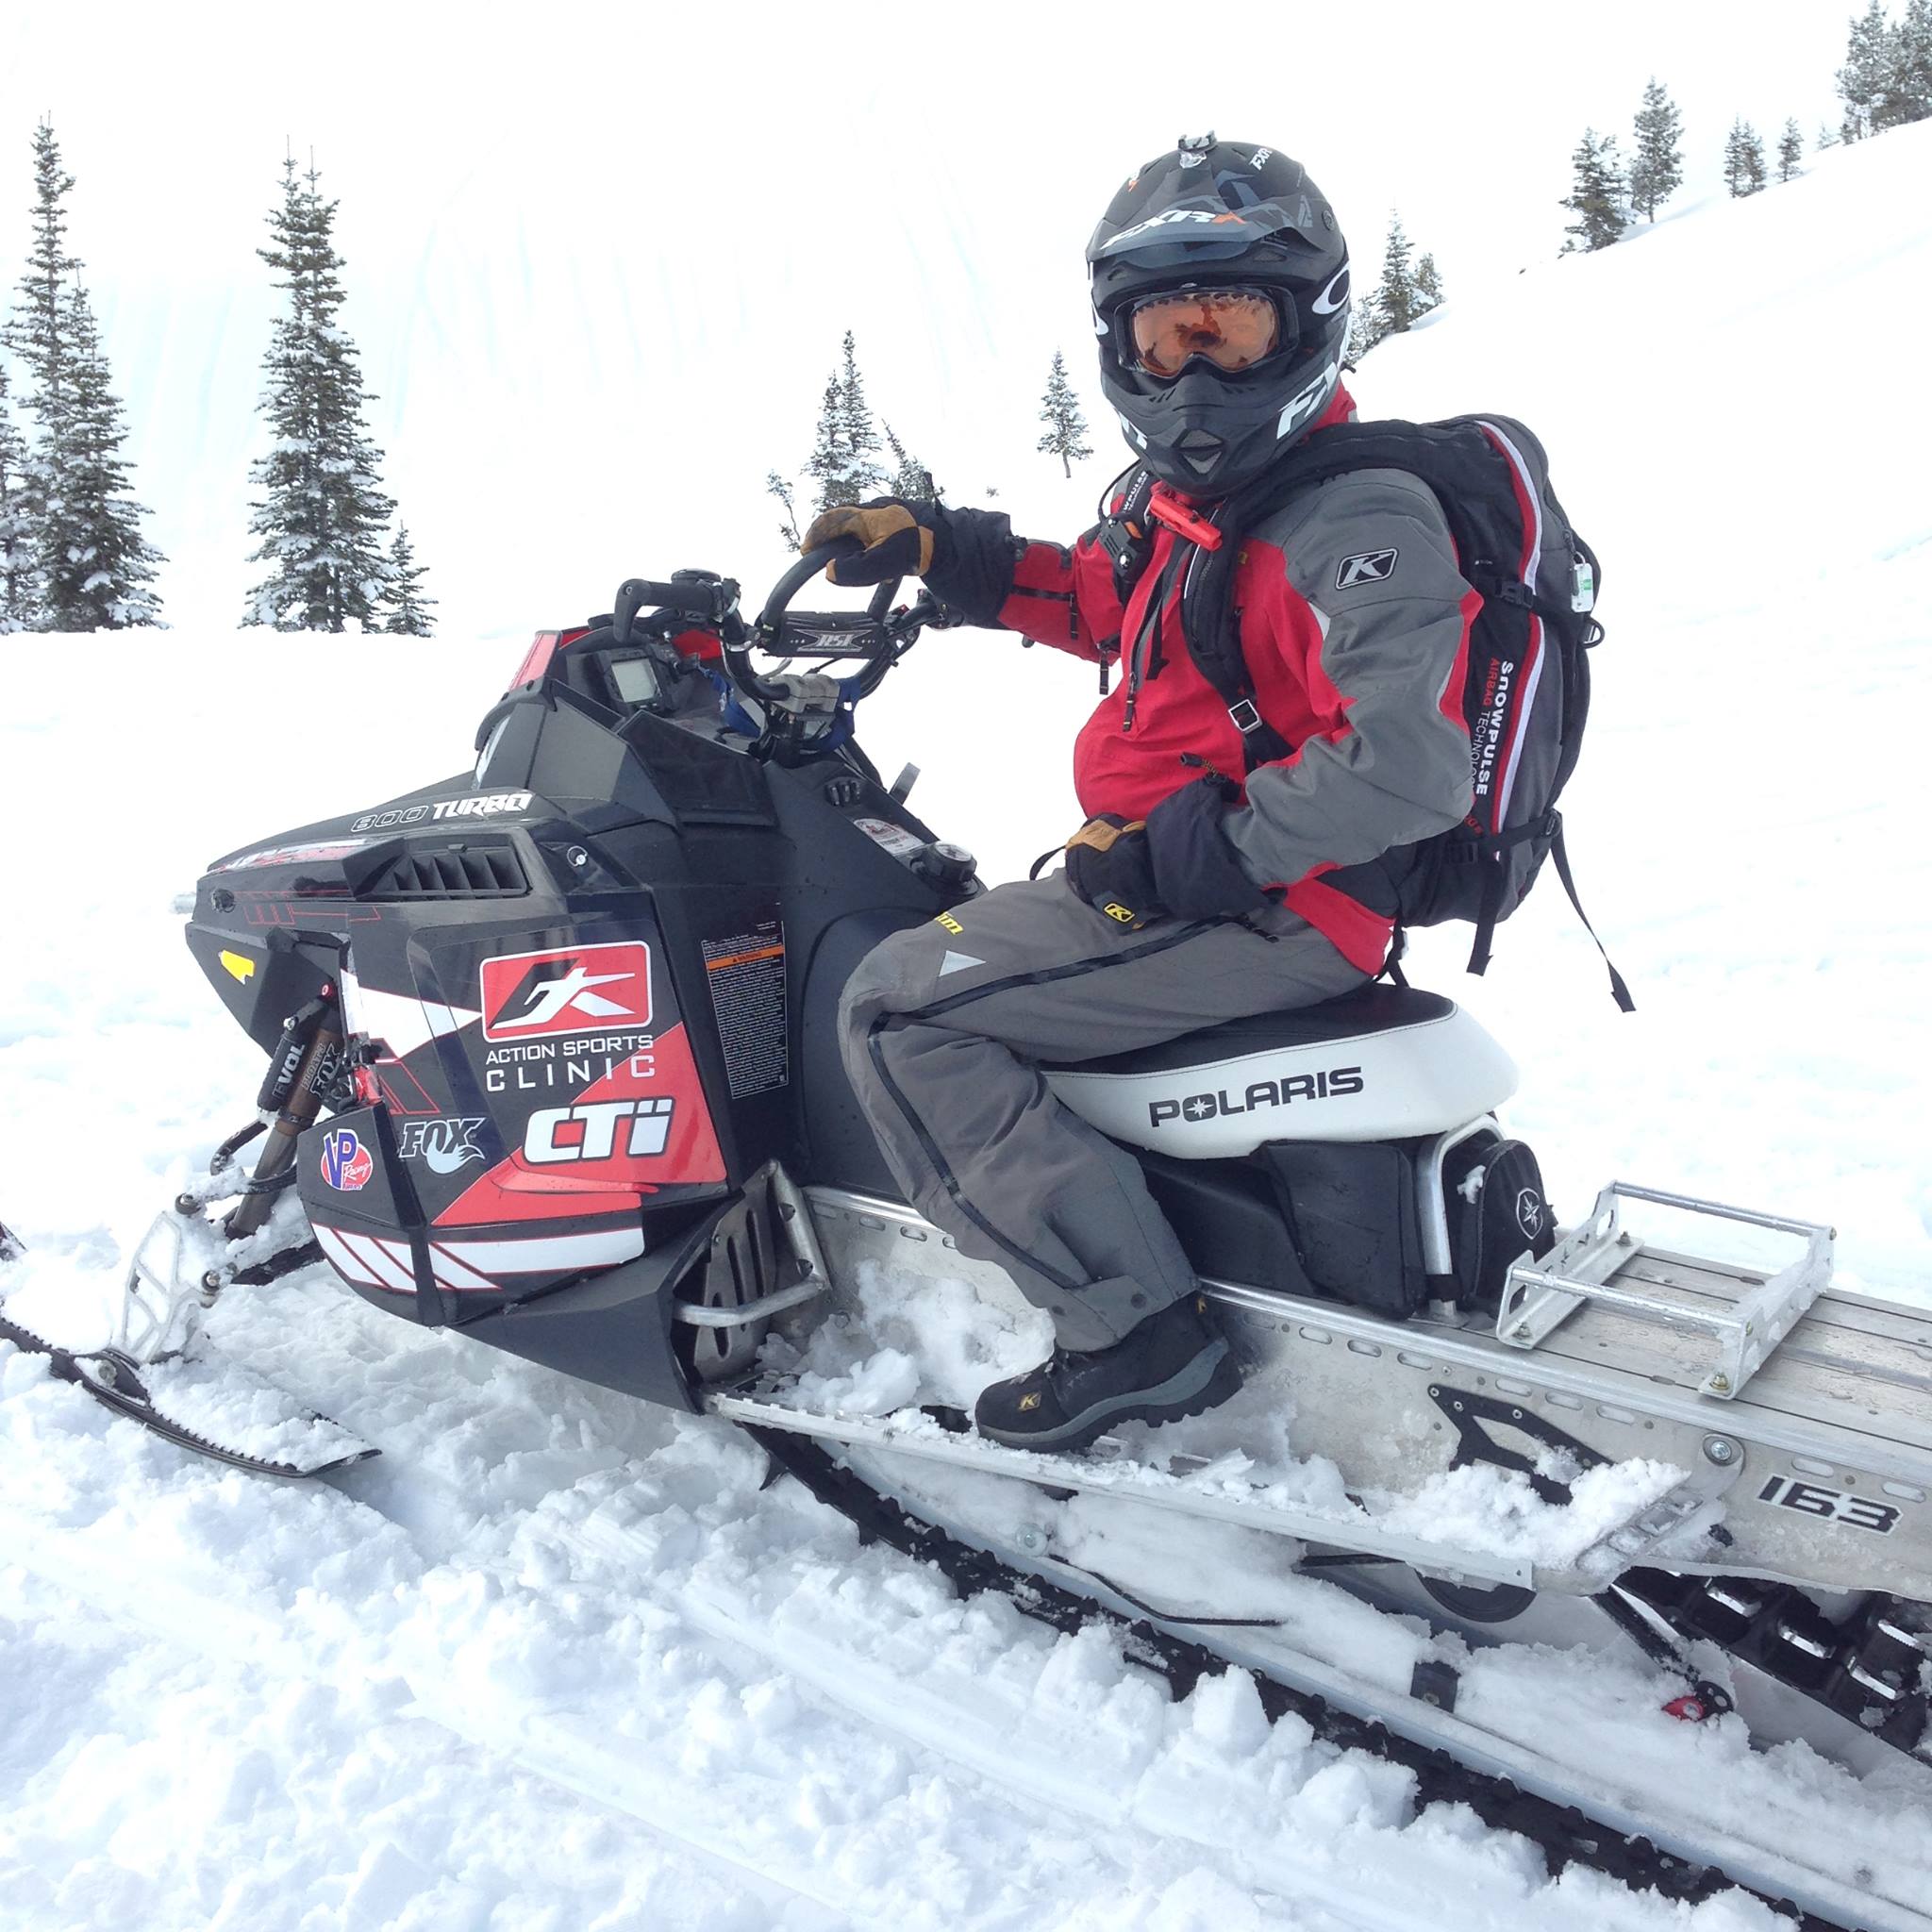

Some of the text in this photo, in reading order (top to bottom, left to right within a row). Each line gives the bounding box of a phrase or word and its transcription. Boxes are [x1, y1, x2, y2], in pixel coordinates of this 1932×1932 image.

[1248, 147, 1273, 171] FXR
[1482, 658, 1500, 707] AIRBAG
[351, 792, 534, 833] 800 TURBO
[309, 1042, 341, 1097] FOX
[486, 1035, 654, 1065] ACTION SPORTS
[486, 1055, 656, 1092] CLINIC
[1149, 1066, 1364, 1127] POLARIS
[324, 1128, 358, 1190] VP
[399, 1117, 486, 1166] FOX
[1757, 1474, 1903, 1535] 163
